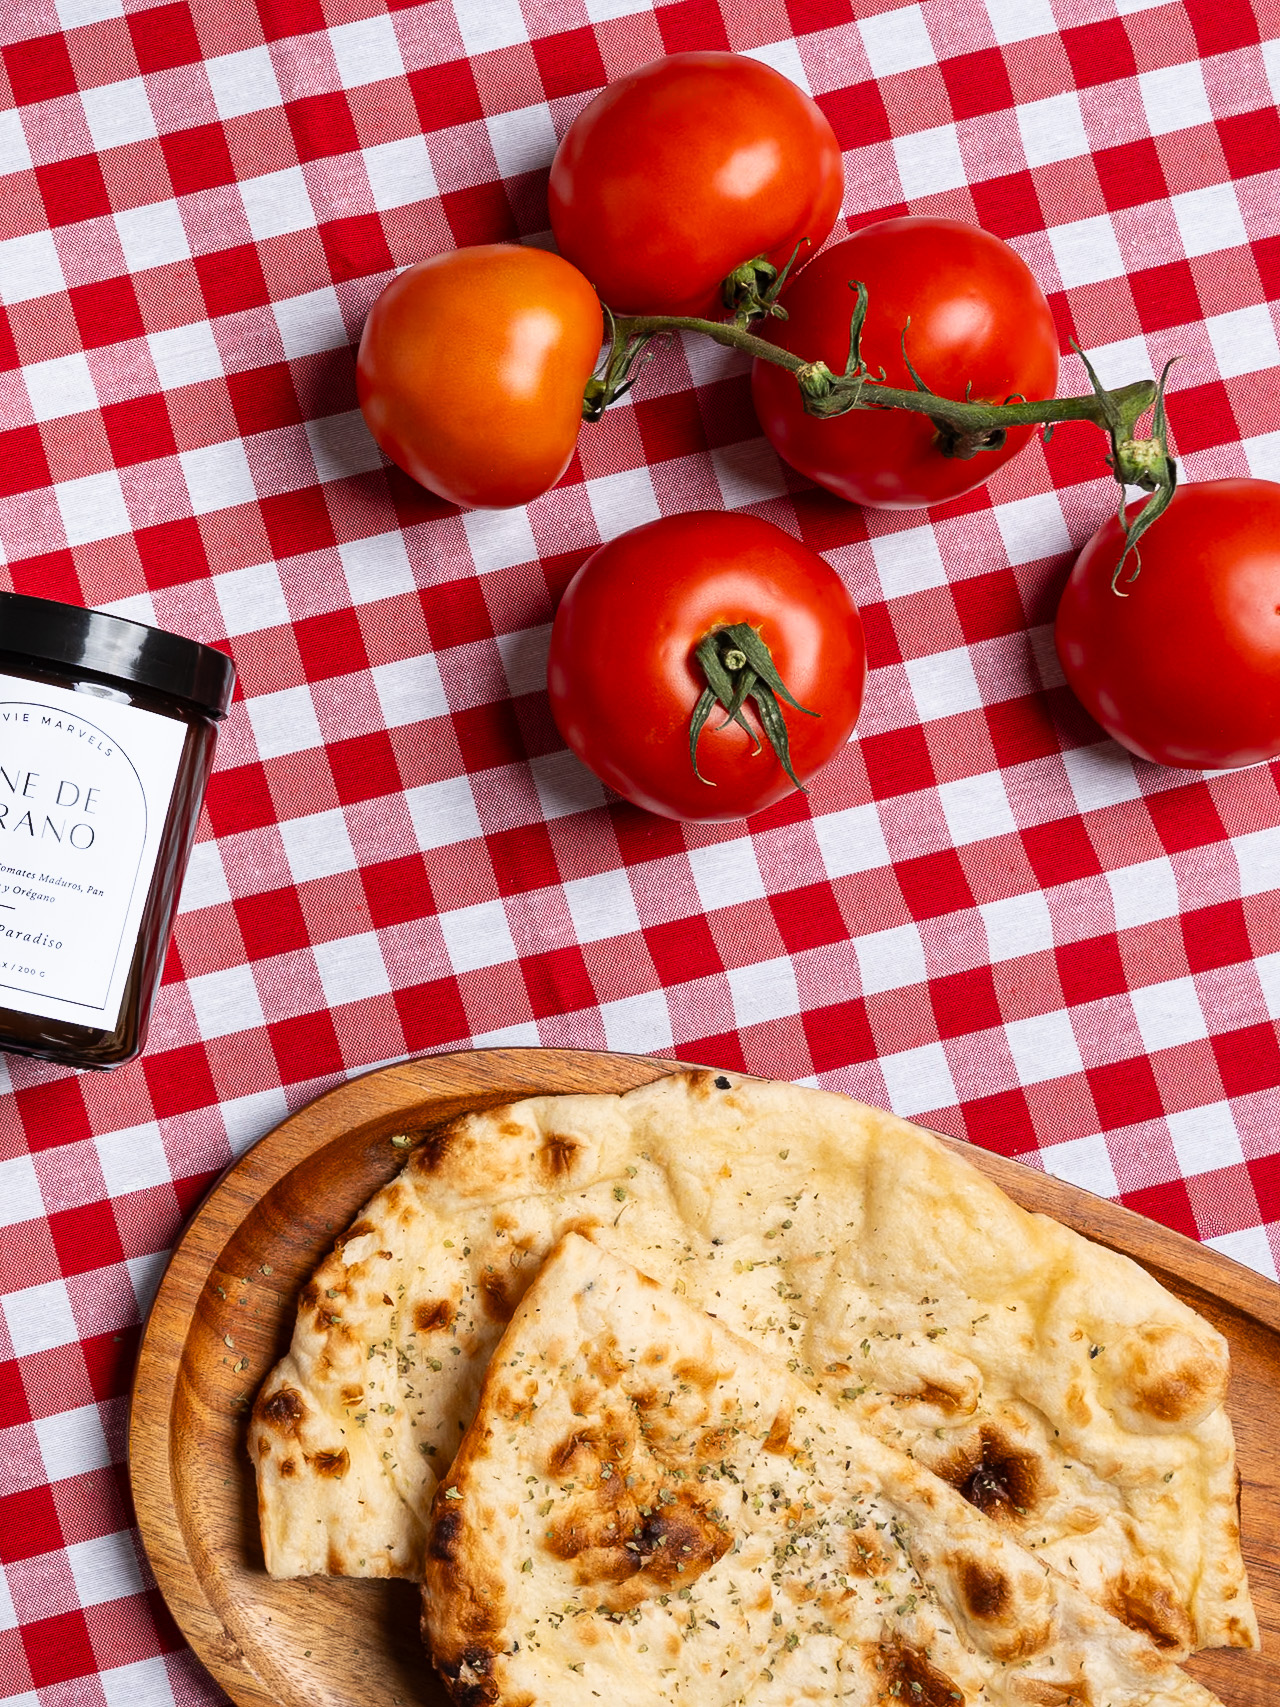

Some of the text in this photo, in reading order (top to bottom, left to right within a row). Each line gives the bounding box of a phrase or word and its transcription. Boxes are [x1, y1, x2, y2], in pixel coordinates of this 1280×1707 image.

[41, 716, 113, 757] MARVELS
[55, 780, 101, 815] DE
[2, 884, 11, 894] y
[12, 885, 56, 904] Orégano
[38, 873, 84, 893] Maduros,
[86, 884, 105, 898] Pan
[18, 965, 37, 976] 200
